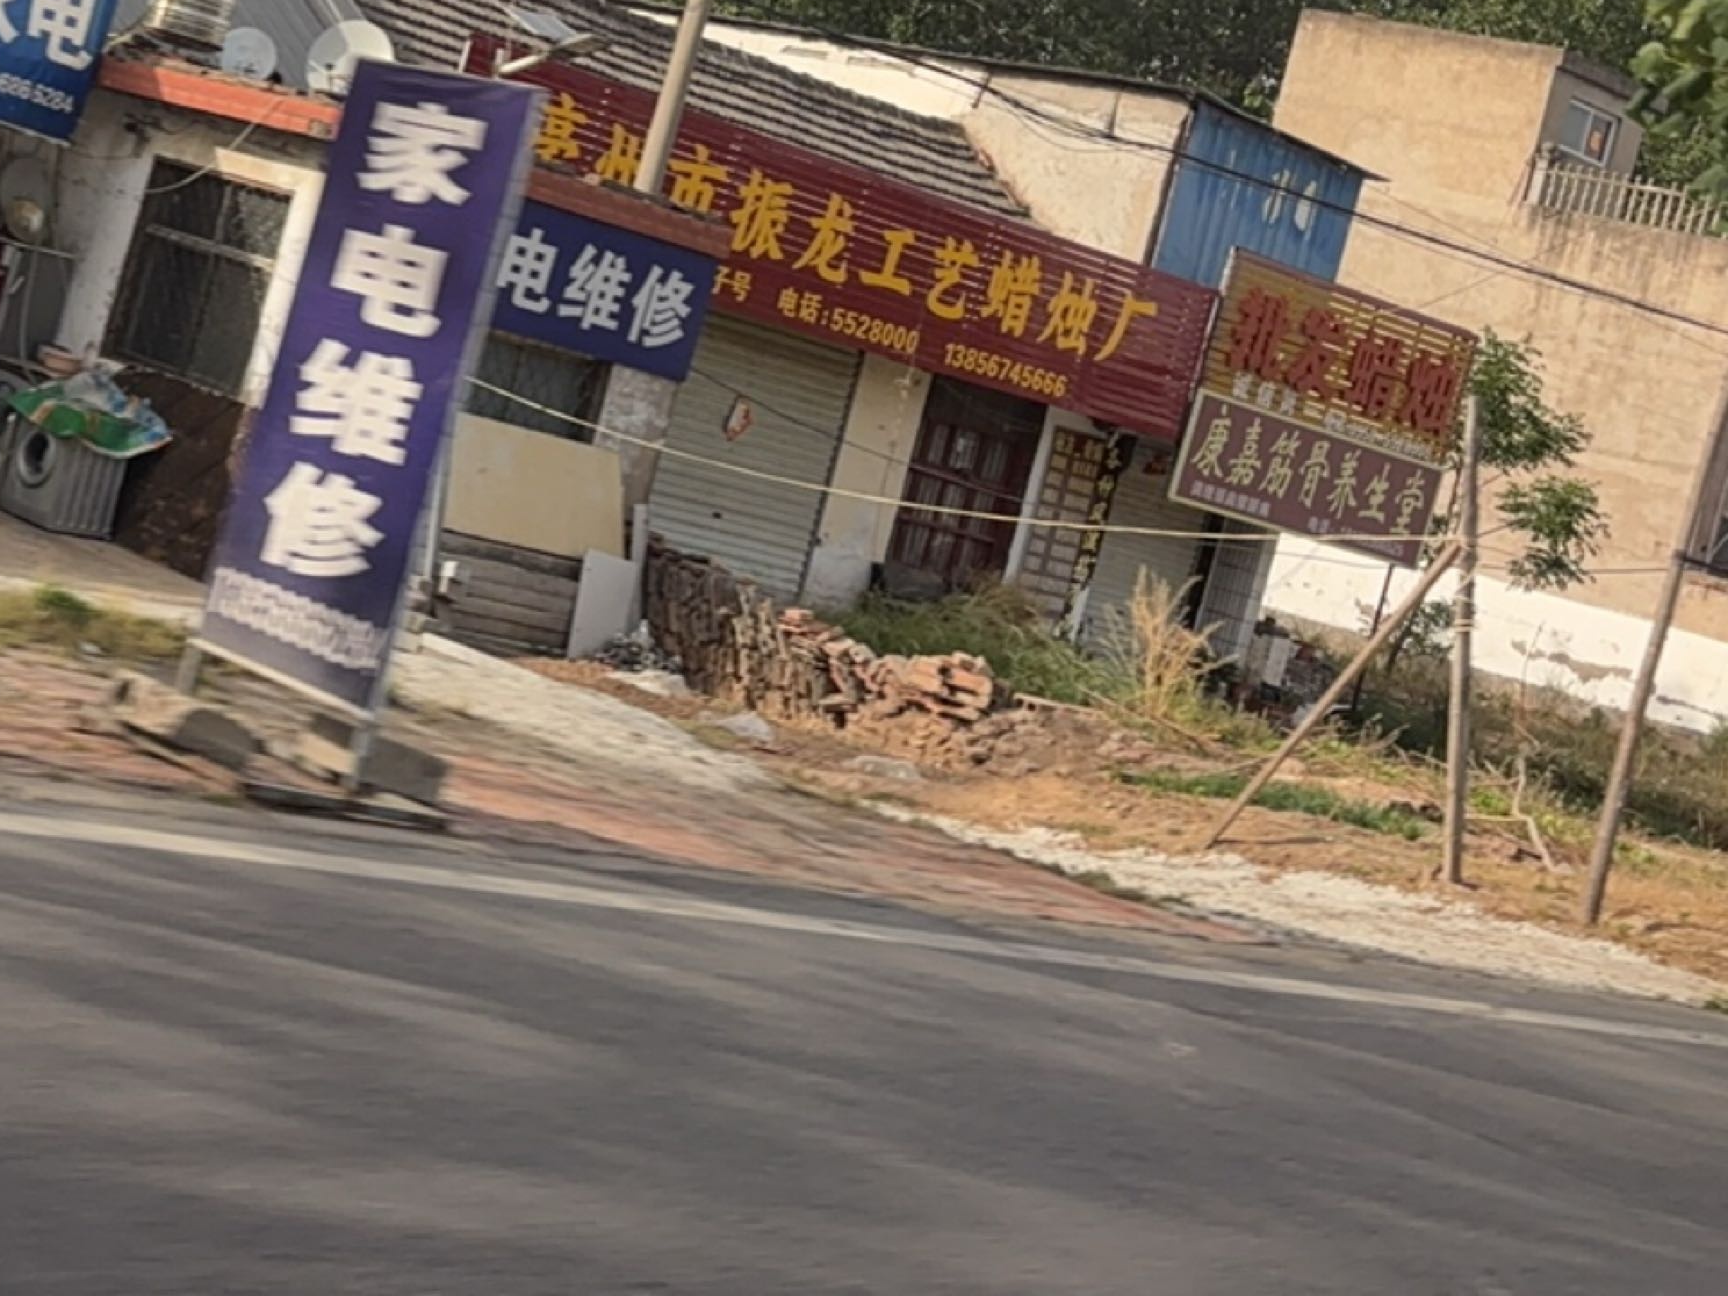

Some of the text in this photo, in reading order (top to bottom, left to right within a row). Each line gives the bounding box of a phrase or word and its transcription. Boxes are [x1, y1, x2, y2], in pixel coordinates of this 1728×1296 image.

[260, 101, 489, 579] 家电维修
[496, 227, 695, 348] 电维修
[944, 343, 1069, 397] 13856745666
[1226, 286, 1461, 438] 批发蜡烛
[1191, 403, 1427, 537] 康嘉筋骨养生堂
